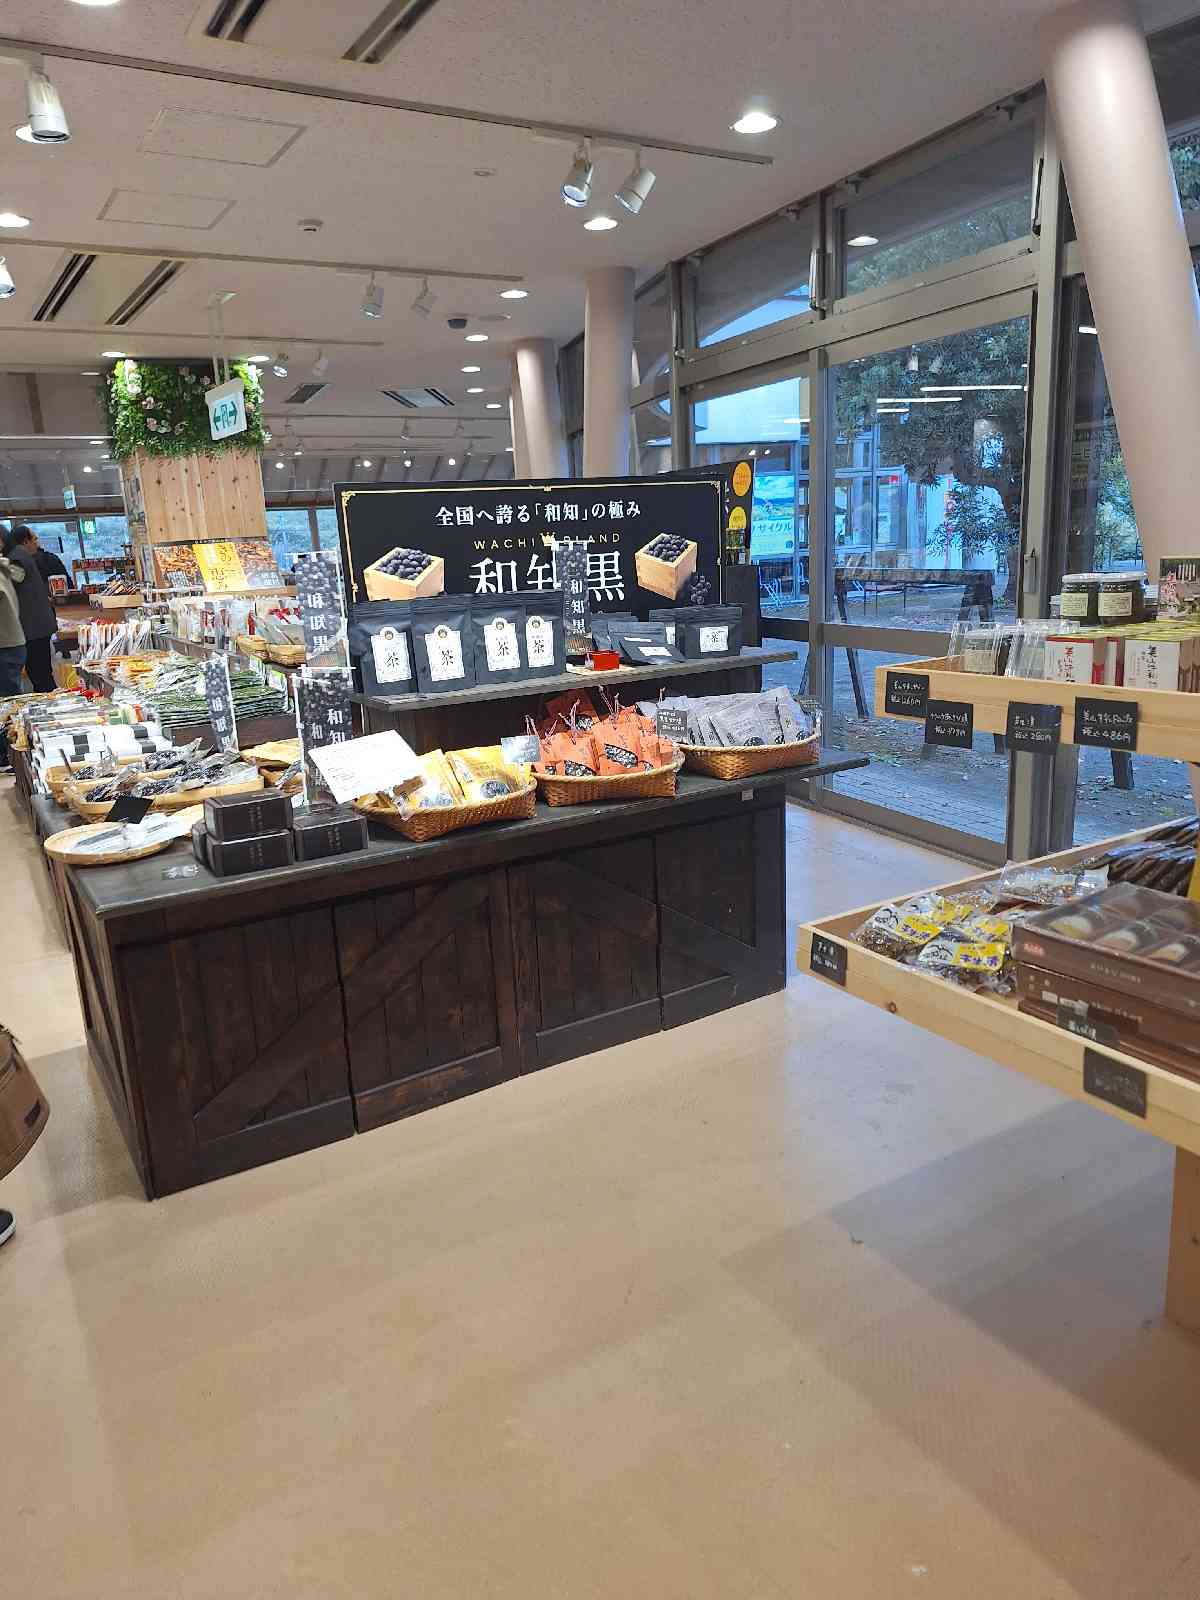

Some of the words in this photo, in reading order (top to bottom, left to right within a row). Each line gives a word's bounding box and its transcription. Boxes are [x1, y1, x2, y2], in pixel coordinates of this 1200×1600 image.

[435, 500, 641, 526] 全国へ誇る「和知」の極み
[474, 538, 535, 550] WACHI
